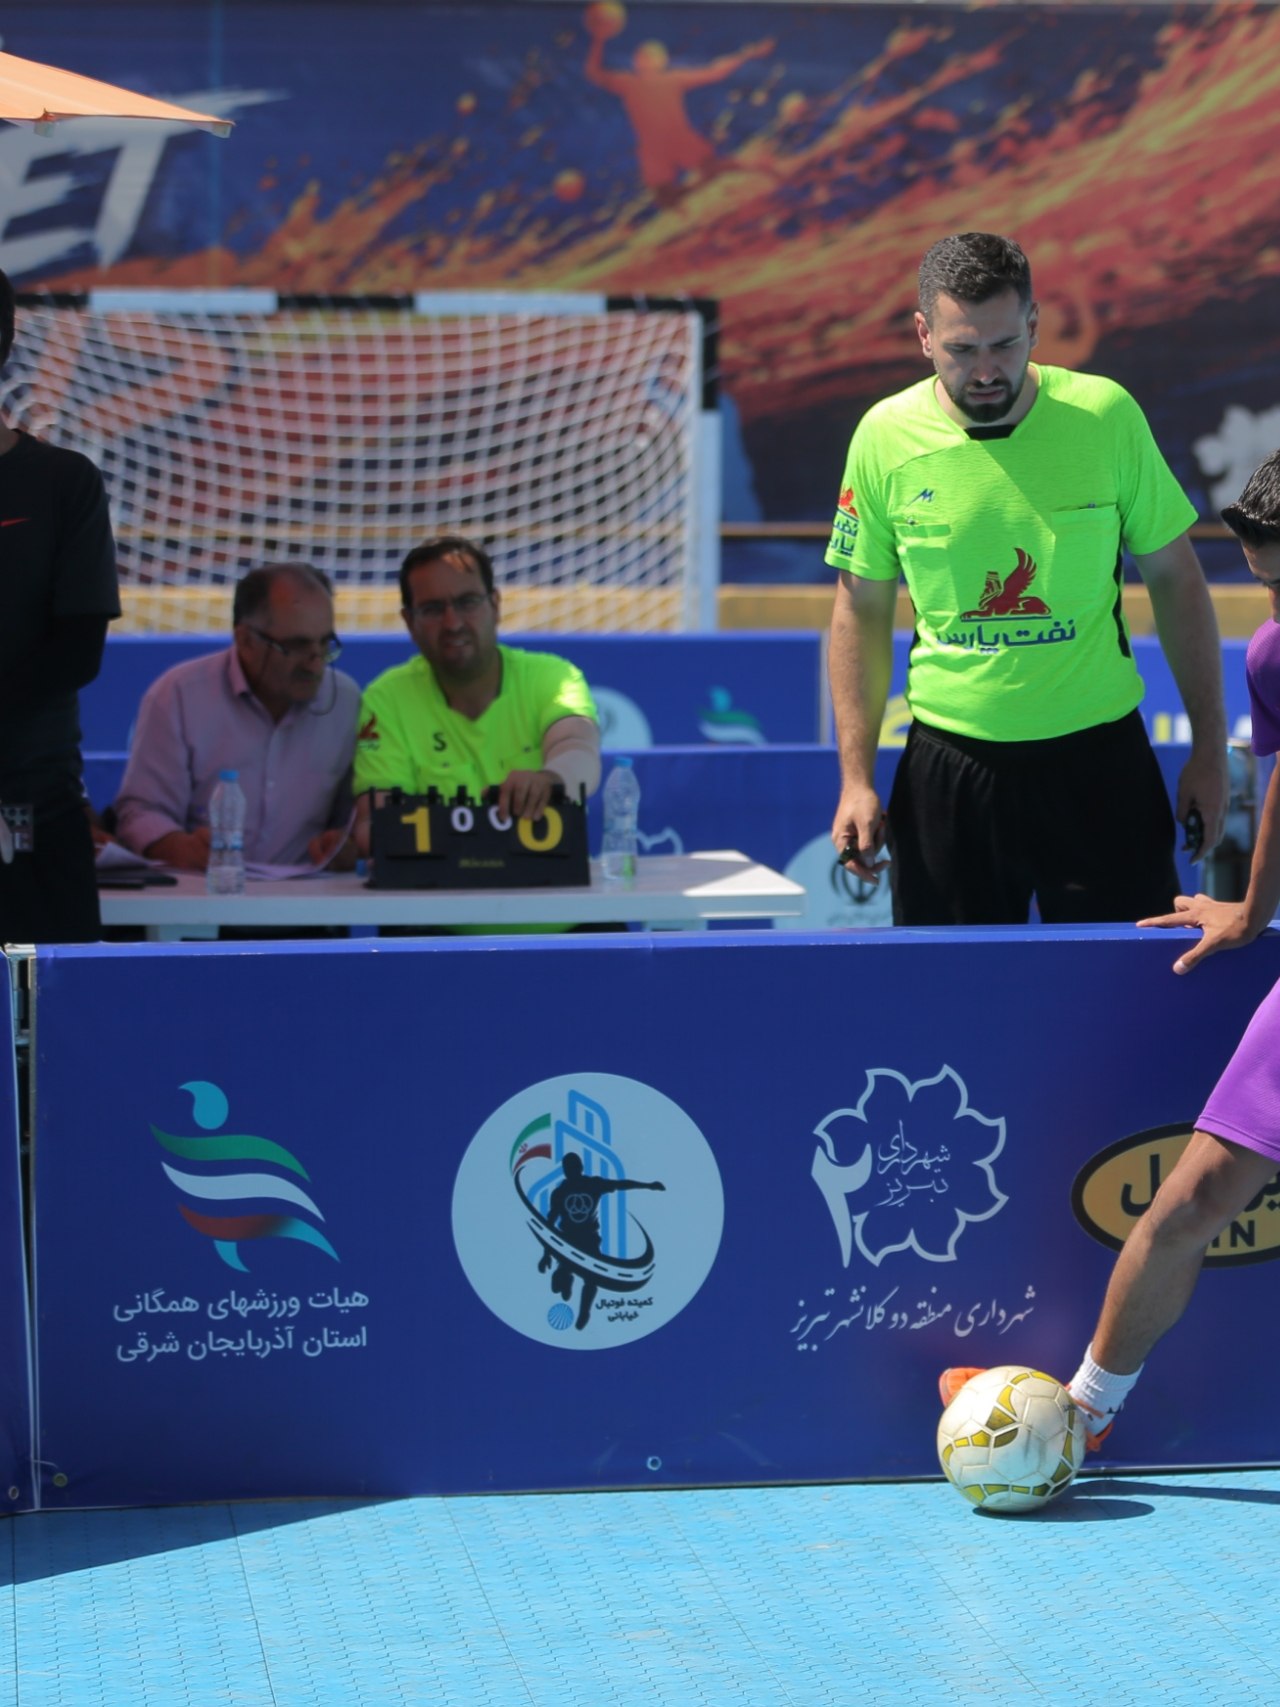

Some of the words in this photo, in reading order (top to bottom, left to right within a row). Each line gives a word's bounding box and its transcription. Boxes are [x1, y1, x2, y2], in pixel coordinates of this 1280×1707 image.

[936, 624, 1000, 654] پارس
[1002, 619, 1076, 647] نفت
[401, 806, 431, 853] 1
[451, 806, 474, 832] 0
[517, 807, 563, 852] 0
[113, 1289, 200, 1322] همگانی
[207, 1289, 301, 1319] ورزشهای
[308, 1288, 369, 1313] هیات
[595, 1298, 625, 1310] فوتبال
[626, 1296, 653, 1309] کمیته
[909, 1286, 952, 1329] منطقه
[954, 1285, 1036, 1338] شهرداری
[790, 1288, 836, 1352] تبریز
[888, 1312, 908, 1329] دو
[117, 1332, 180, 1363] شرقی
[187, 1326, 295, 1361] آذربایجان
[303, 1327, 367, 1358] استان
